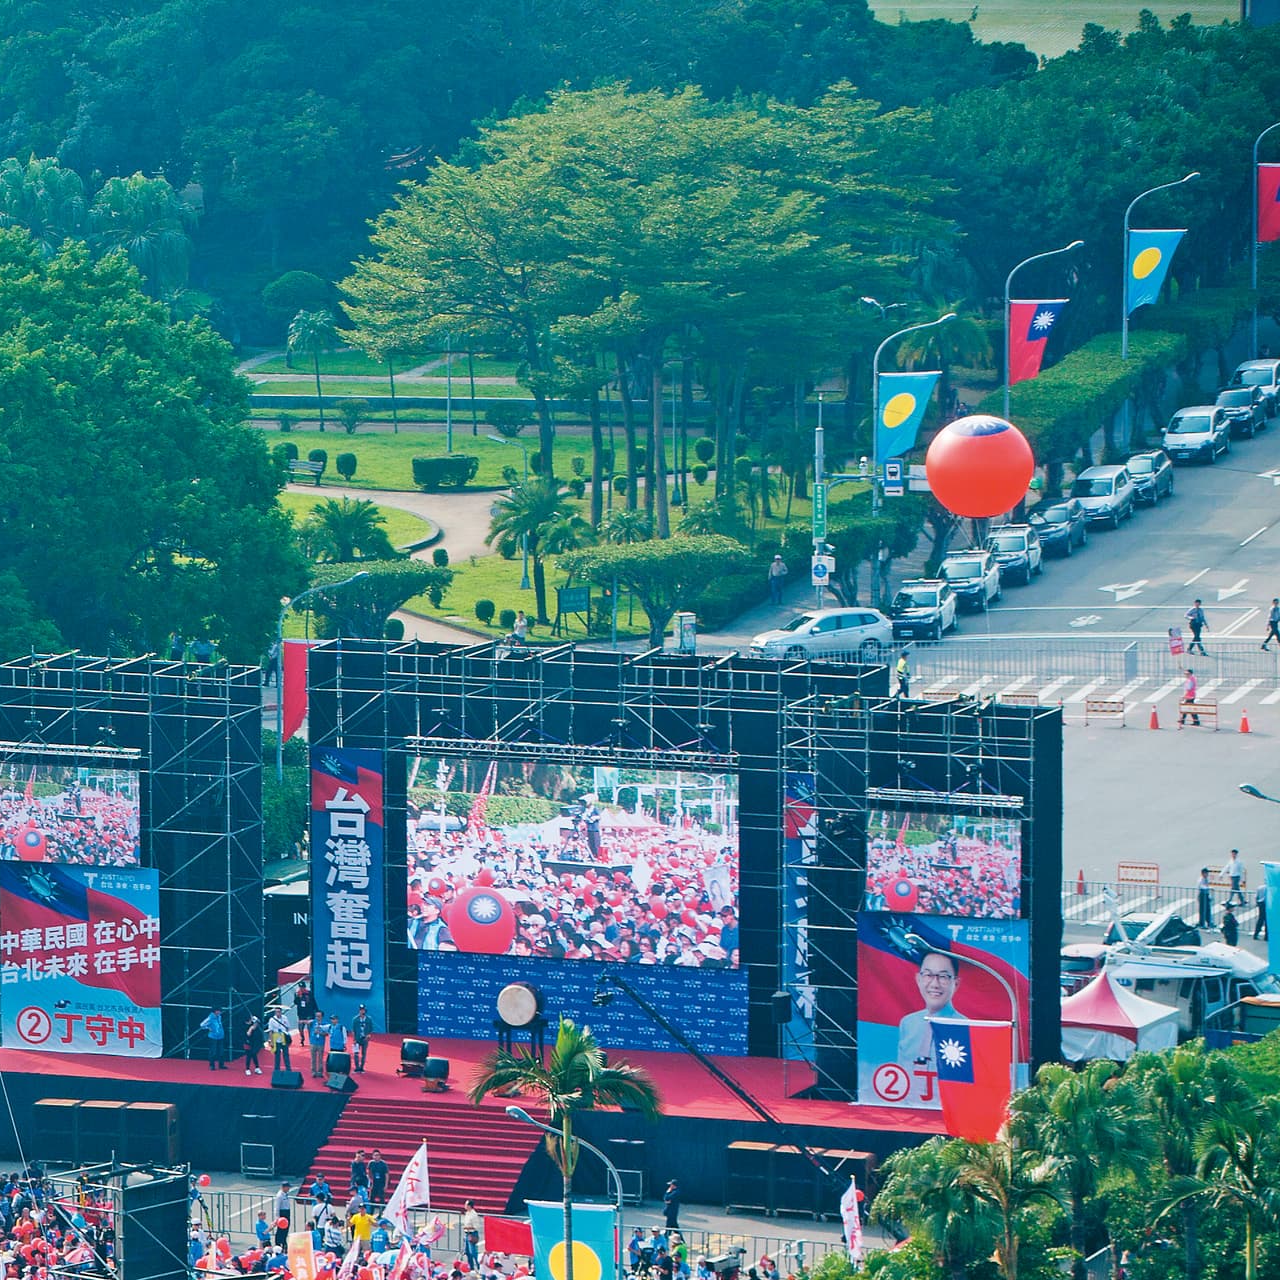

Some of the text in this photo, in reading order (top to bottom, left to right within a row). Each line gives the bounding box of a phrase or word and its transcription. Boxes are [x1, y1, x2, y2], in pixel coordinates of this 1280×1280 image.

[324, 786, 373, 992] 台灣奮起
[0, 915, 161, 956] 中華民國 在心中
[1, 944, 161, 985] 台北未來 在手中
